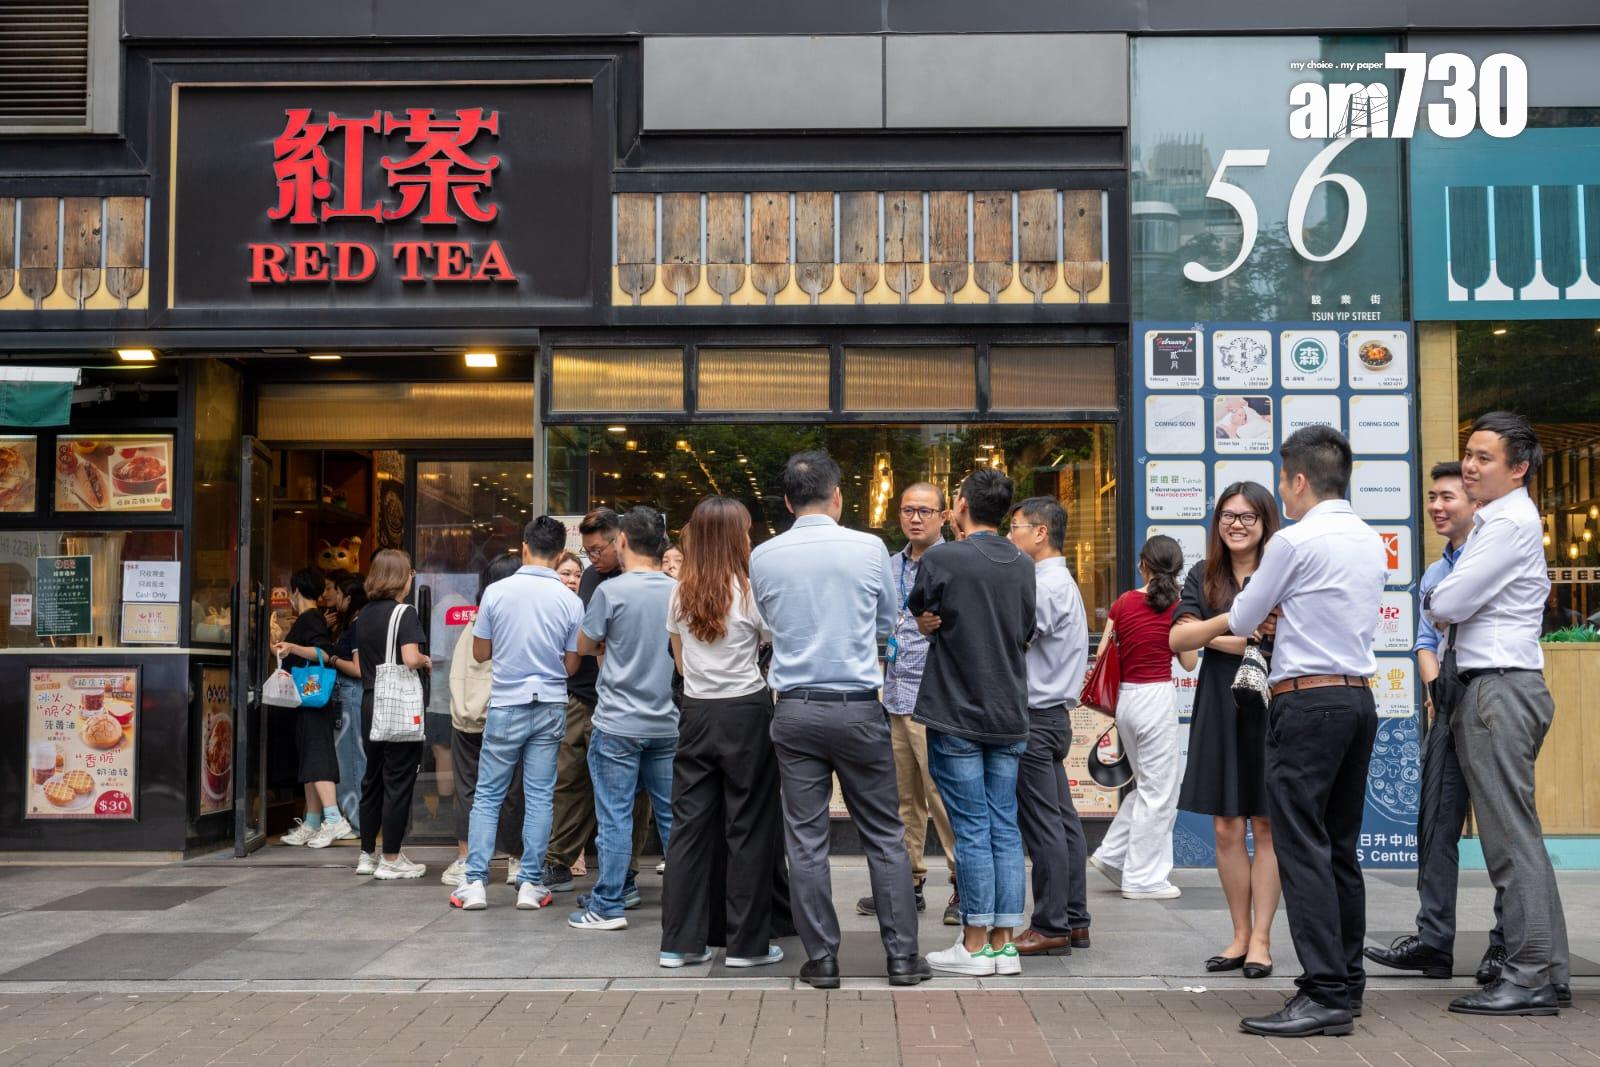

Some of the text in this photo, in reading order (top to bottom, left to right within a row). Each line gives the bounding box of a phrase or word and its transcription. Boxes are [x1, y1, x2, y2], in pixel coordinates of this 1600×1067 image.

[267, 107, 500, 225] 紅茶
[247, 239, 519, 284] RED TEA
[1311, 311, 1381, 321] TSUN YIP STREET
[1299, 346, 1320, 366] 森
[152, 591, 168, 600] Only
[98, 800, 128, 812] $30
[1370, 850, 1418, 862] Centre
